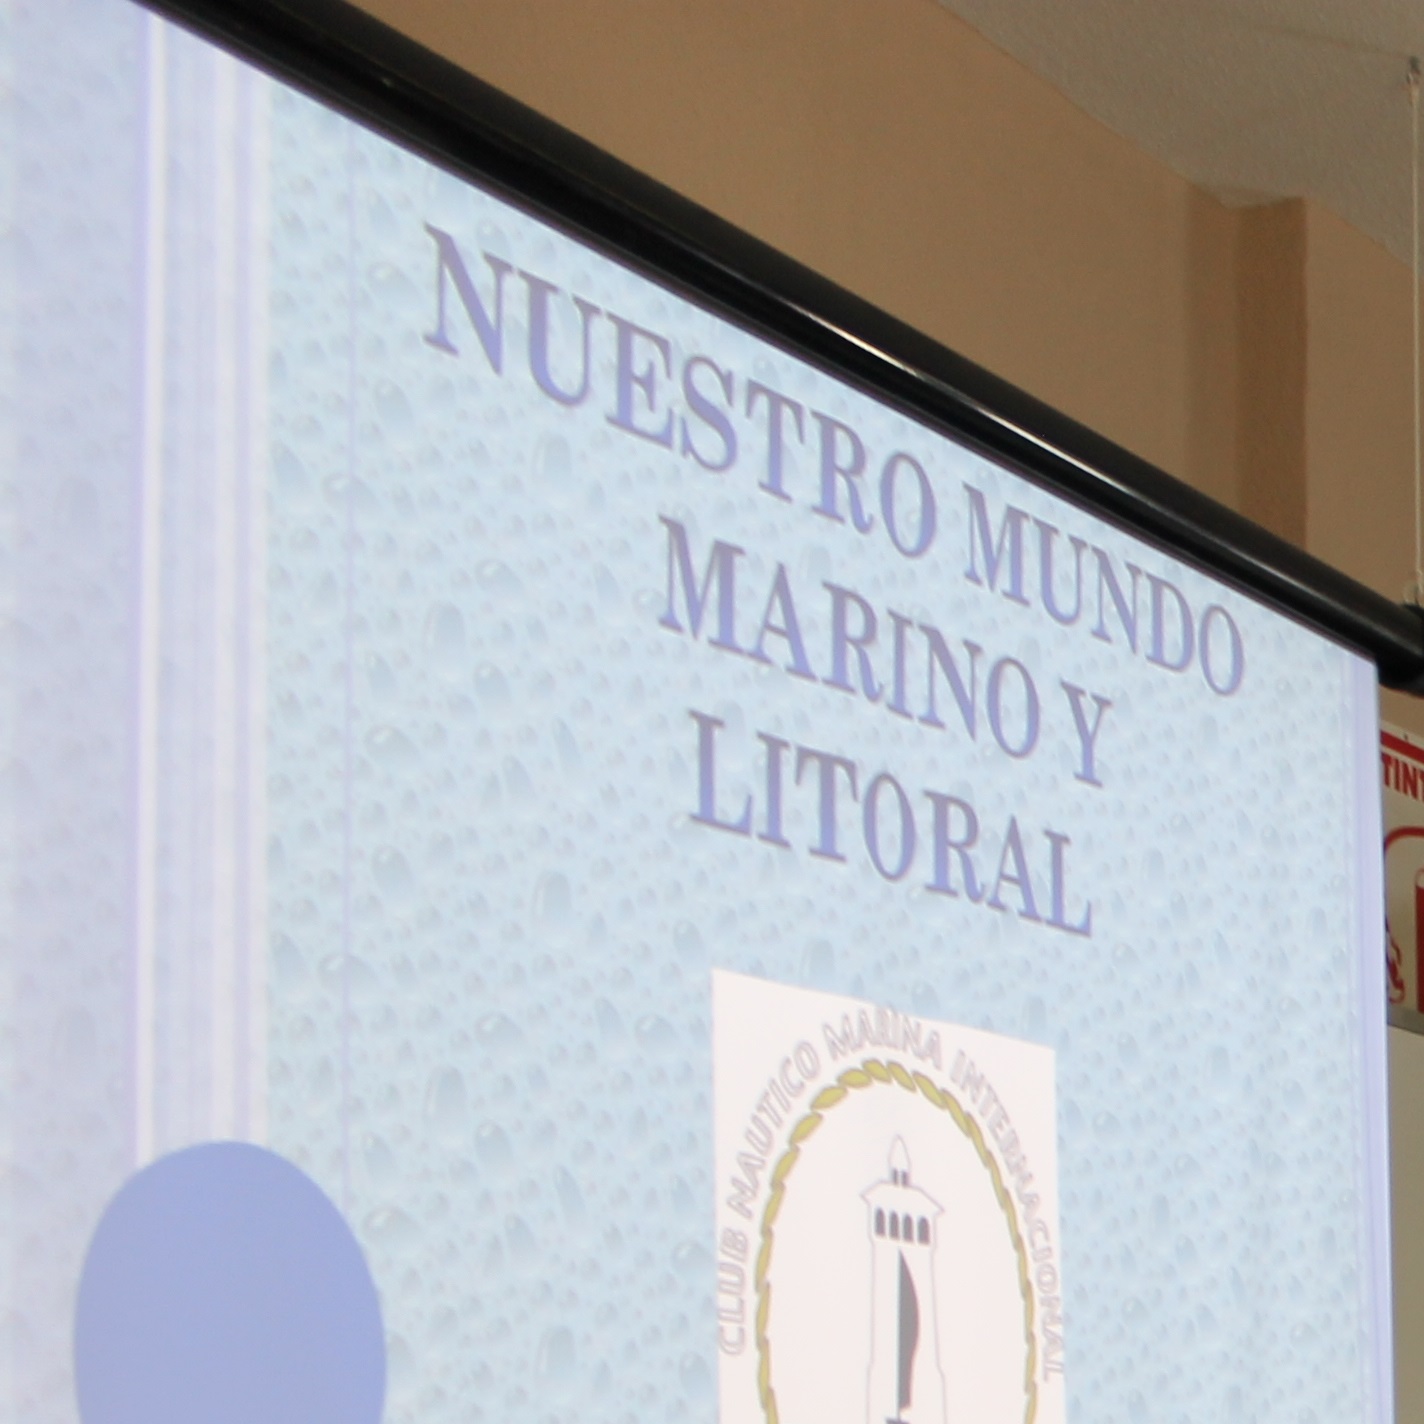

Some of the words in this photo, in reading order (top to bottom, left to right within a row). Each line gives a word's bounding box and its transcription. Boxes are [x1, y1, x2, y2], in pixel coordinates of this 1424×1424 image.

[423, 222, 938, 559] NUESTRO
[962, 481, 1245, 698] MUNDO
[657, 514, 1042, 760] MARINO
[1059, 678, 1114, 788] Y
[687, 709, 1094, 938] LITORAL
